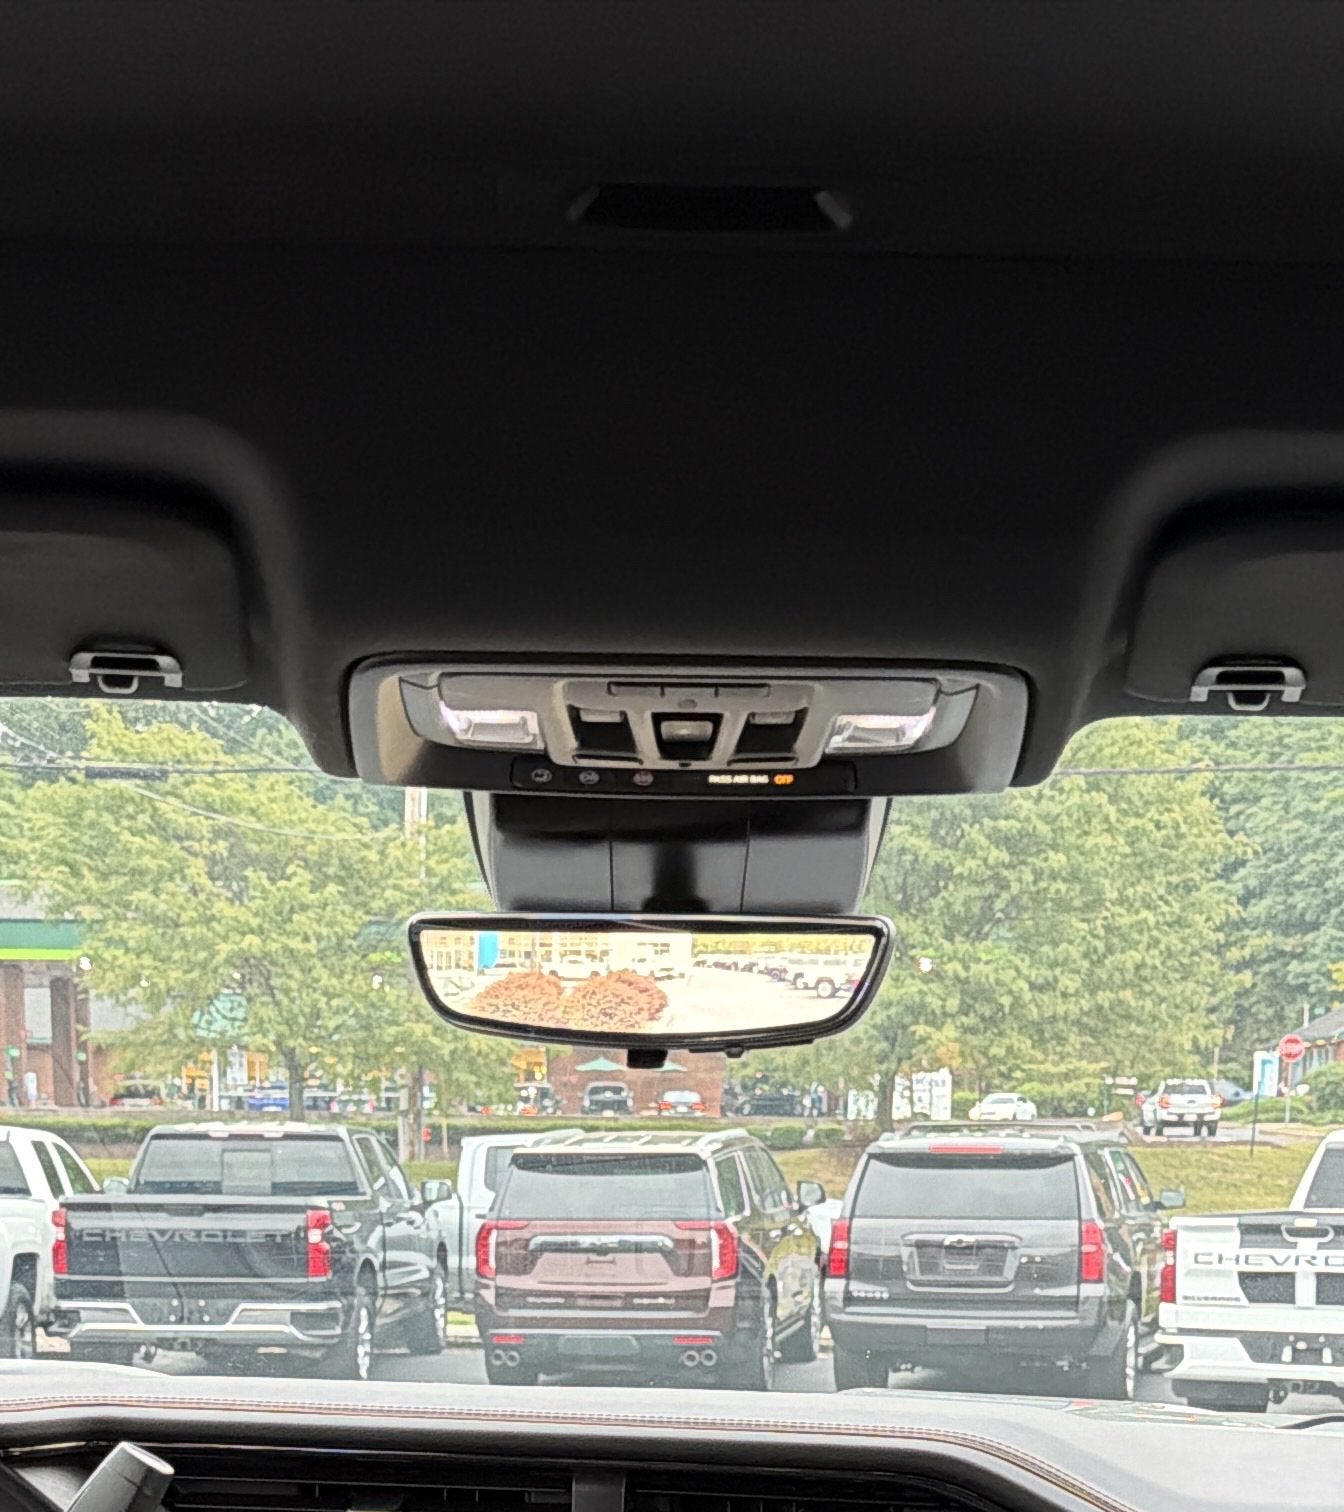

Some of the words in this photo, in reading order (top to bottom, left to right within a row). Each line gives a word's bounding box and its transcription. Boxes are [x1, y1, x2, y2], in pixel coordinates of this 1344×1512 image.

[733, 774, 749, 784] AIR
[774, 774, 794, 785] OFF
[82, 1229, 291, 1244] CHEVROLET
